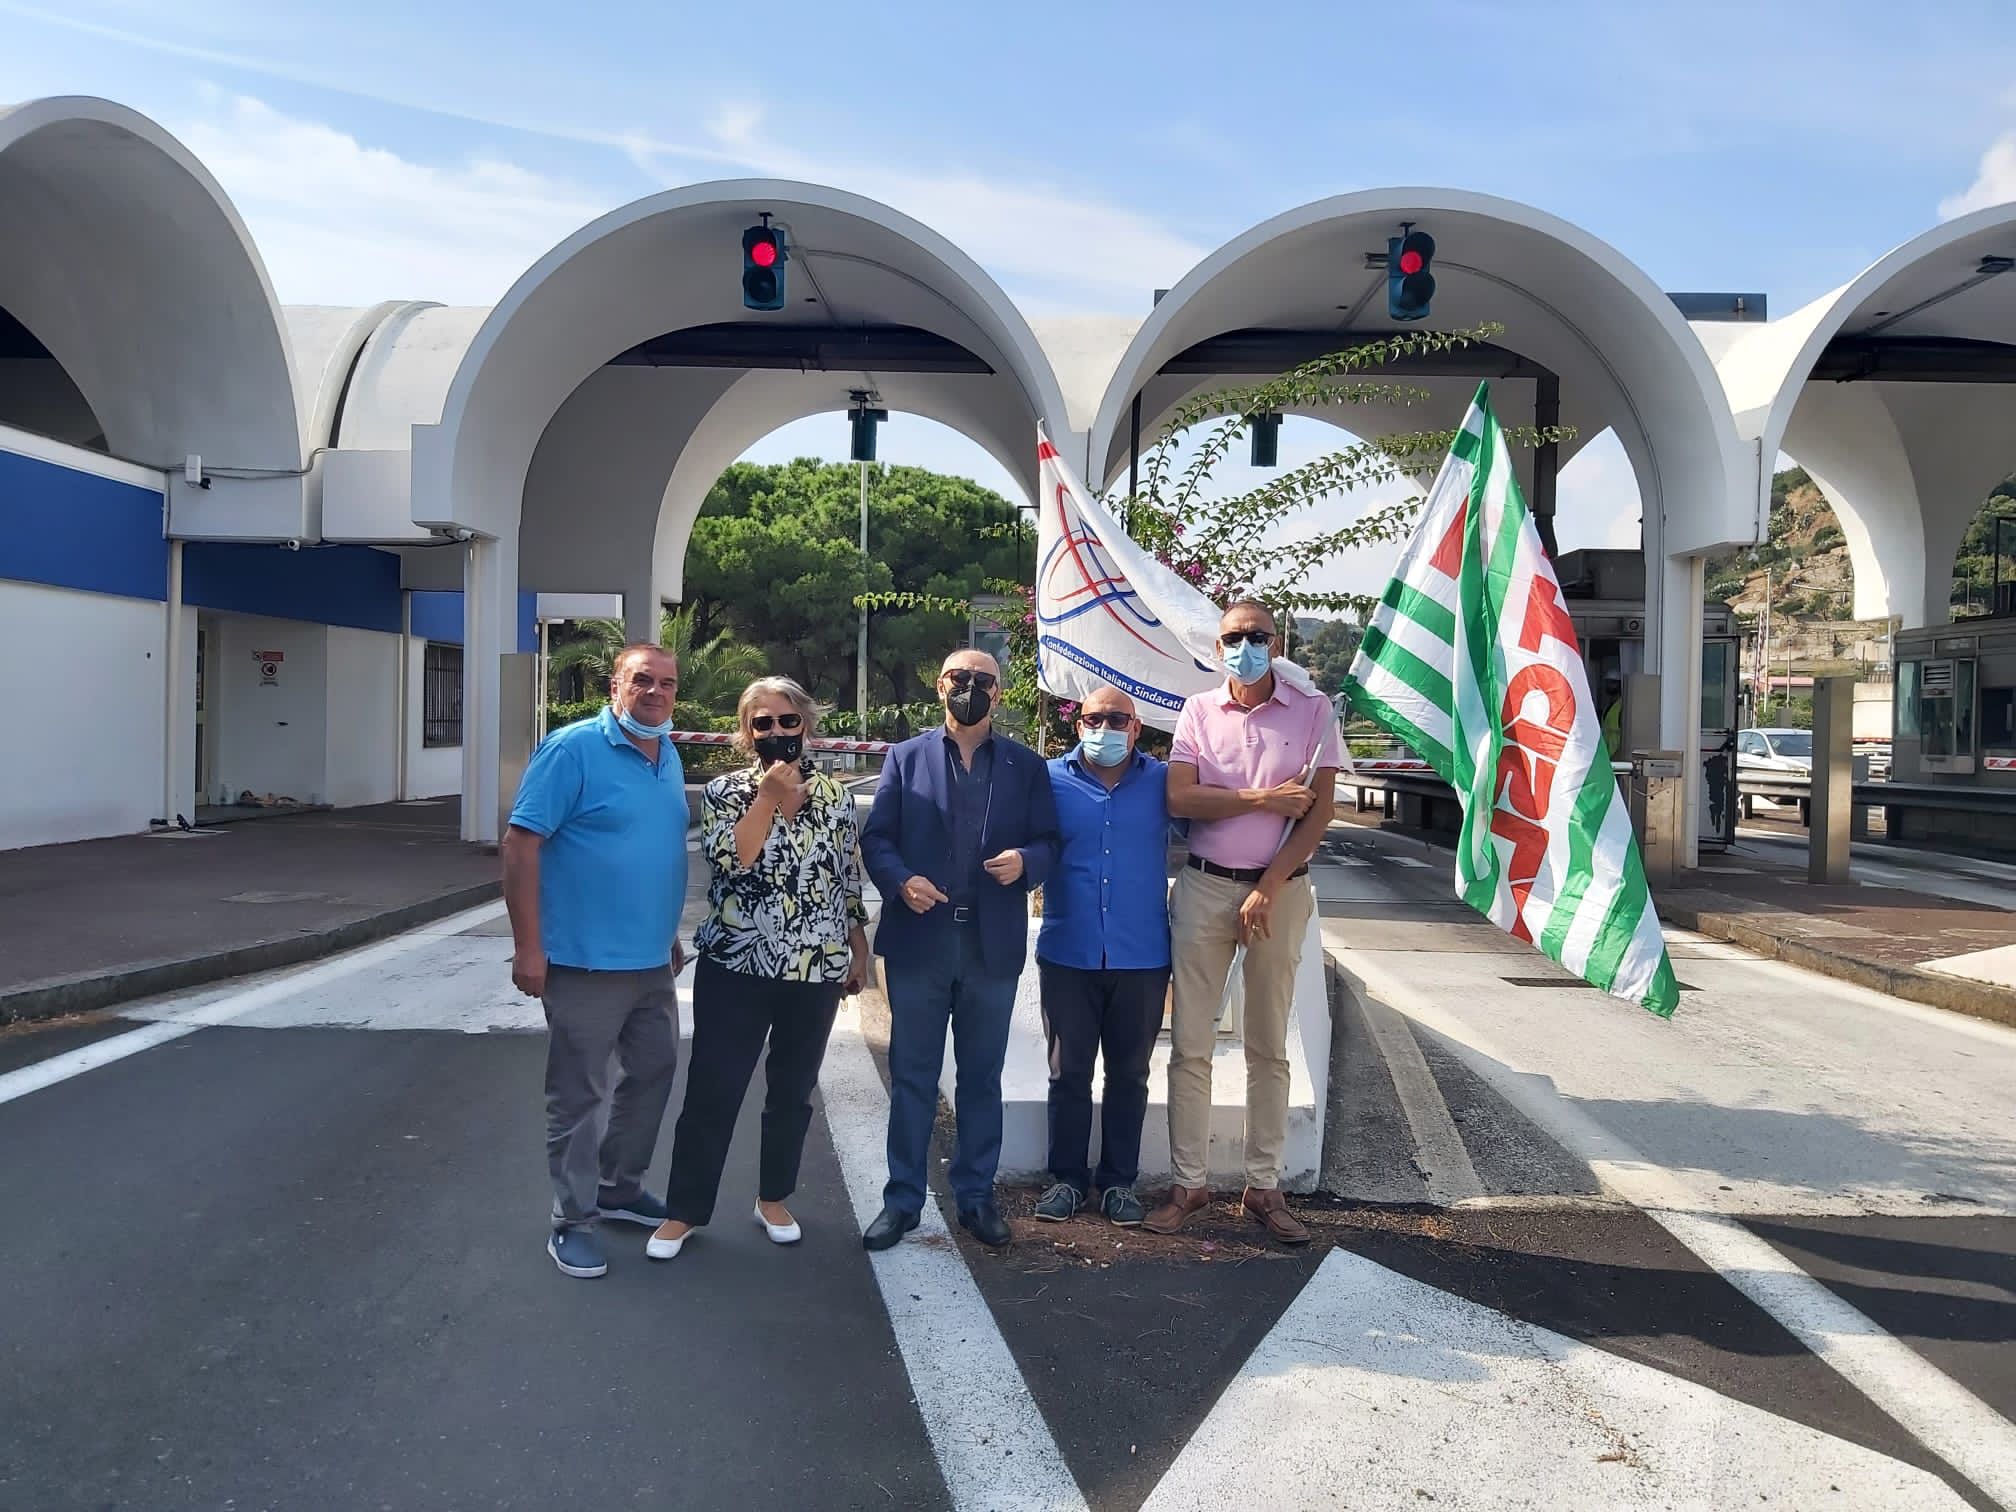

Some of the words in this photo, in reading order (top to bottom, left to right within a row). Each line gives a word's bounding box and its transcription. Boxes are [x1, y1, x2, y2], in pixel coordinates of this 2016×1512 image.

[1045, 636, 1100, 674] Confederazione
[1101, 666, 1133, 693] Italiana
[1134, 685, 1182, 710] Sindacati
